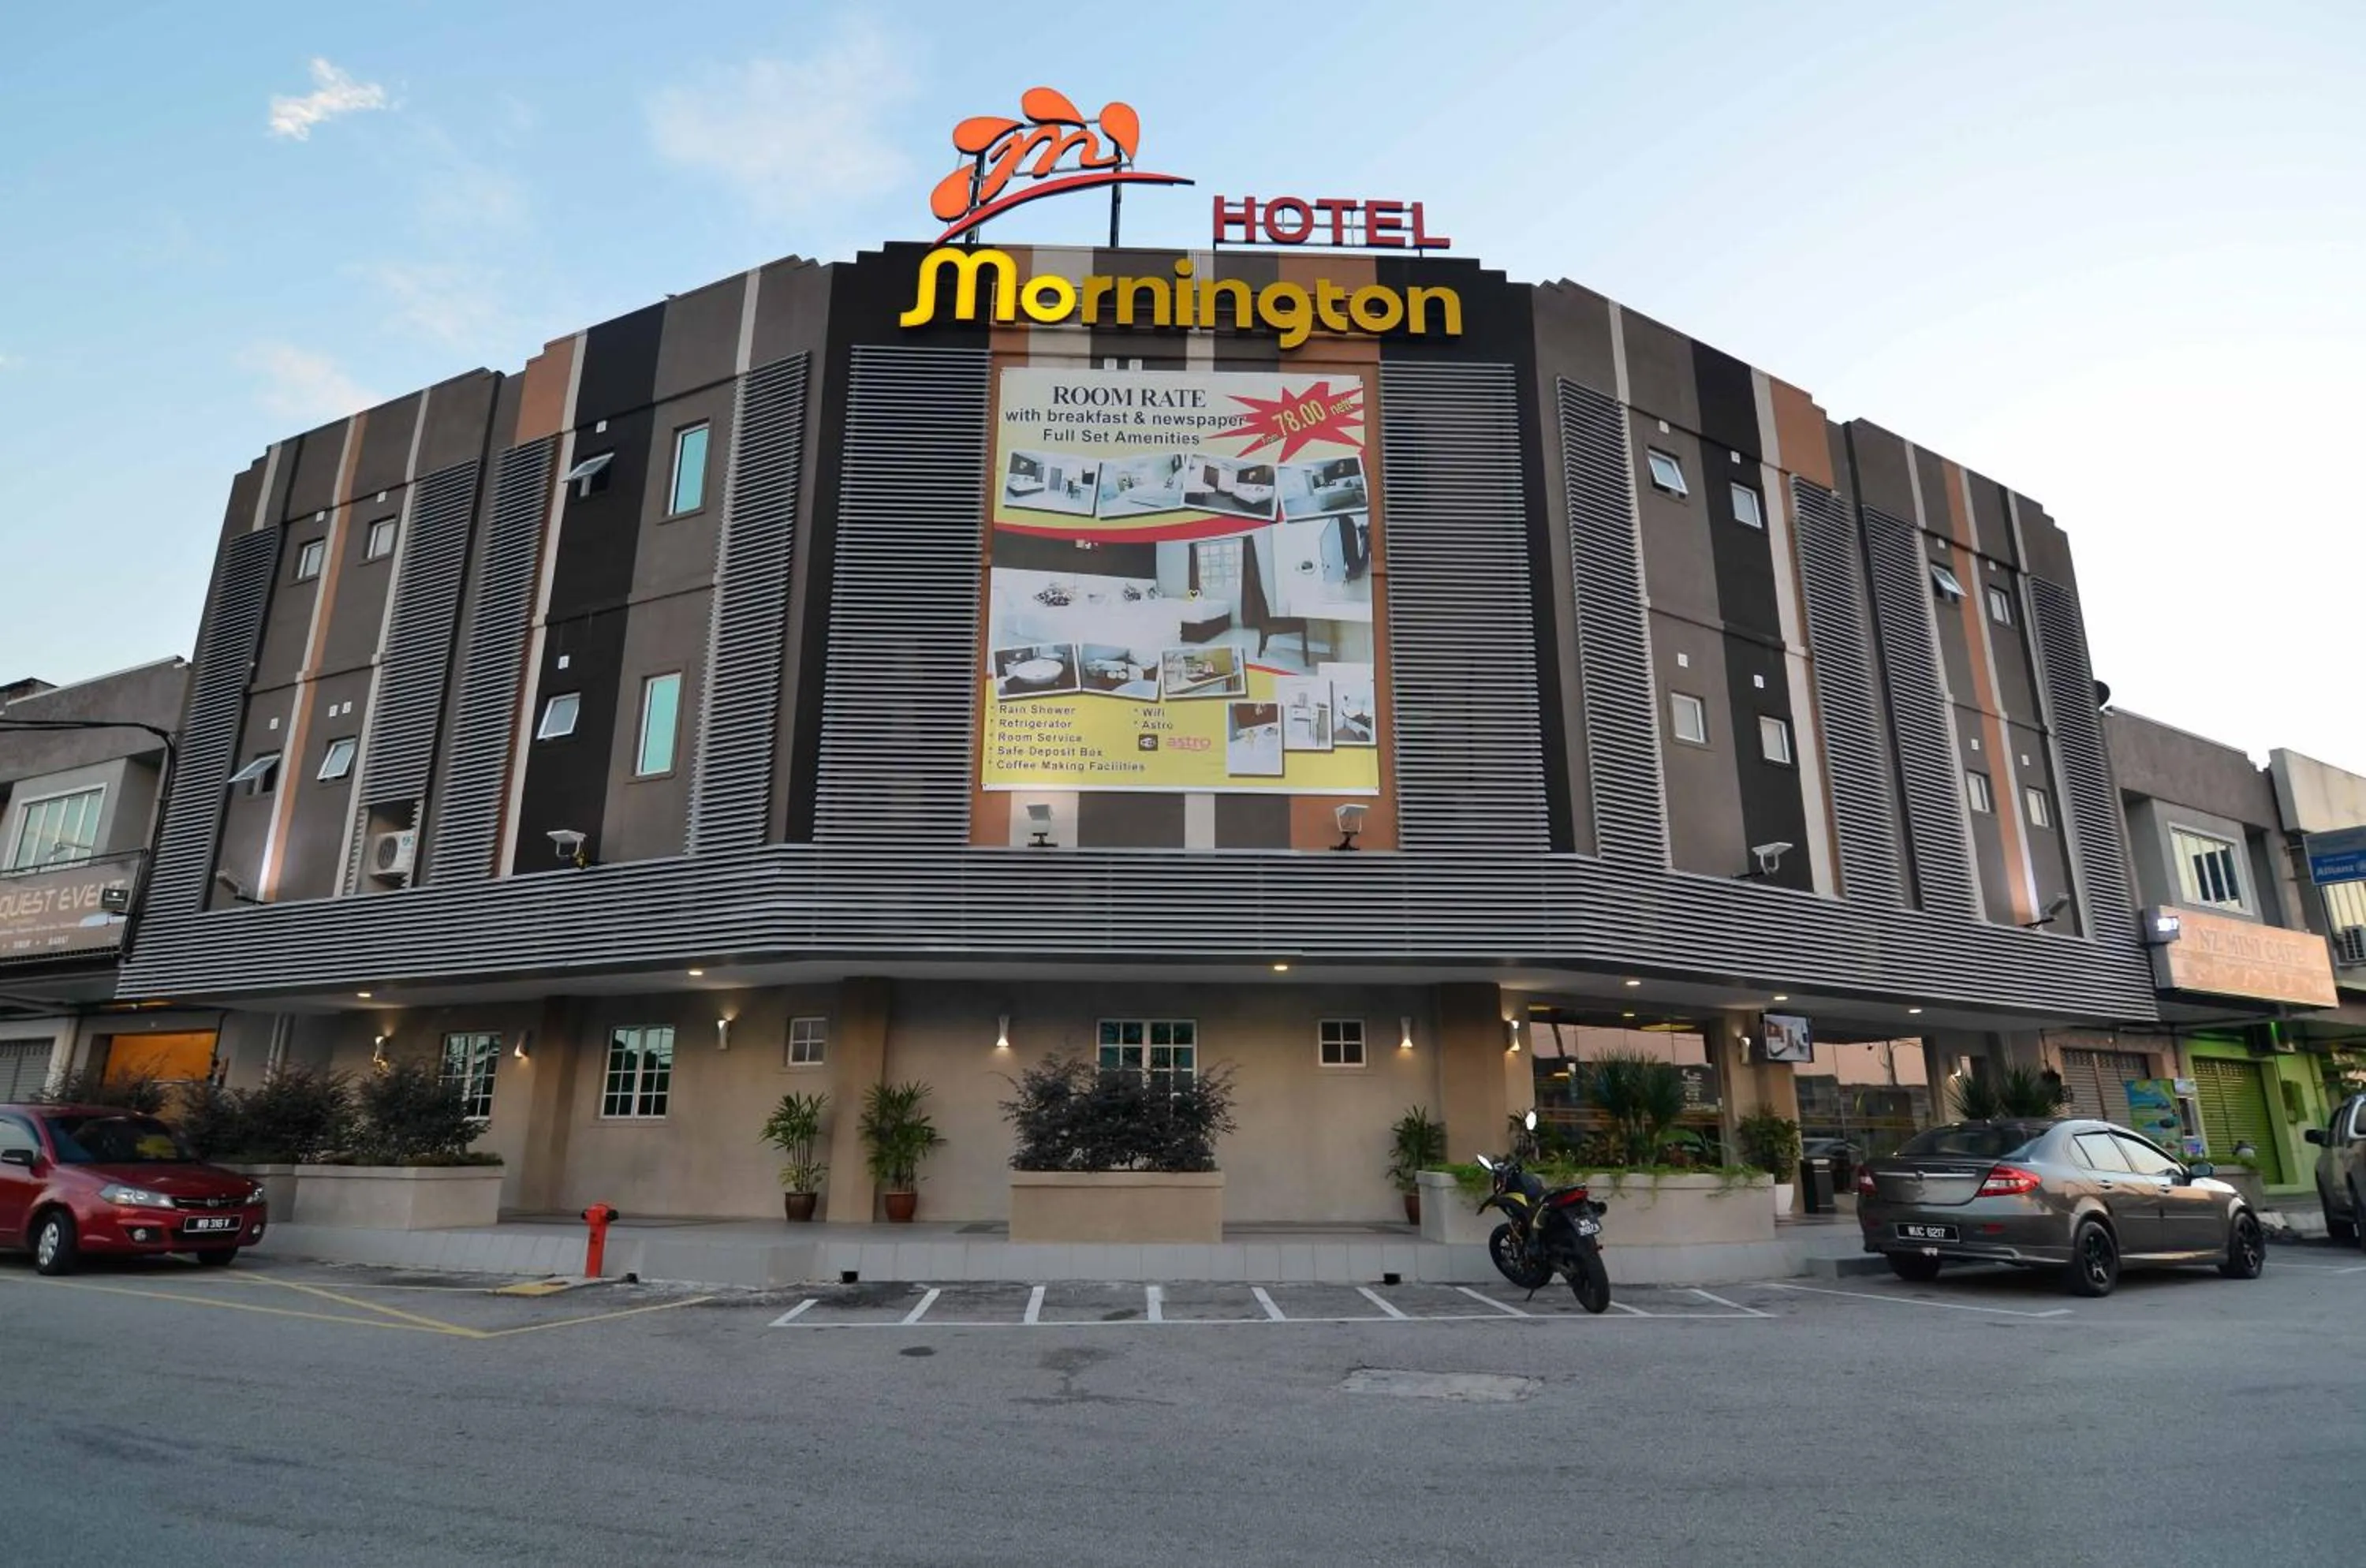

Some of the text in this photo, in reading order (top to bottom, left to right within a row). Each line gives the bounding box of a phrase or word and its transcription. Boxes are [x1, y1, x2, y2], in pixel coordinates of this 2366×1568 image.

[1213, 195, 1450, 249] HOTEL
[900, 248, 1464, 349] Mornington
[1053, 386, 1207, 408] ROOM RATE
[1006, 408, 1247, 429] with breakfast & newspaper
[1271, 399, 1327, 437] 78.00
[1043, 428, 1200, 445] Full Set Amenities
[998, 704, 1077, 715] Rain Shower
[1141, 720, 1174, 730] Astro
[998, 733, 1083, 743] Room Service
[997, 745, 1103, 758] Safe Deposit Box
[995, 760, 1145, 774] Coffee Making Facilities
